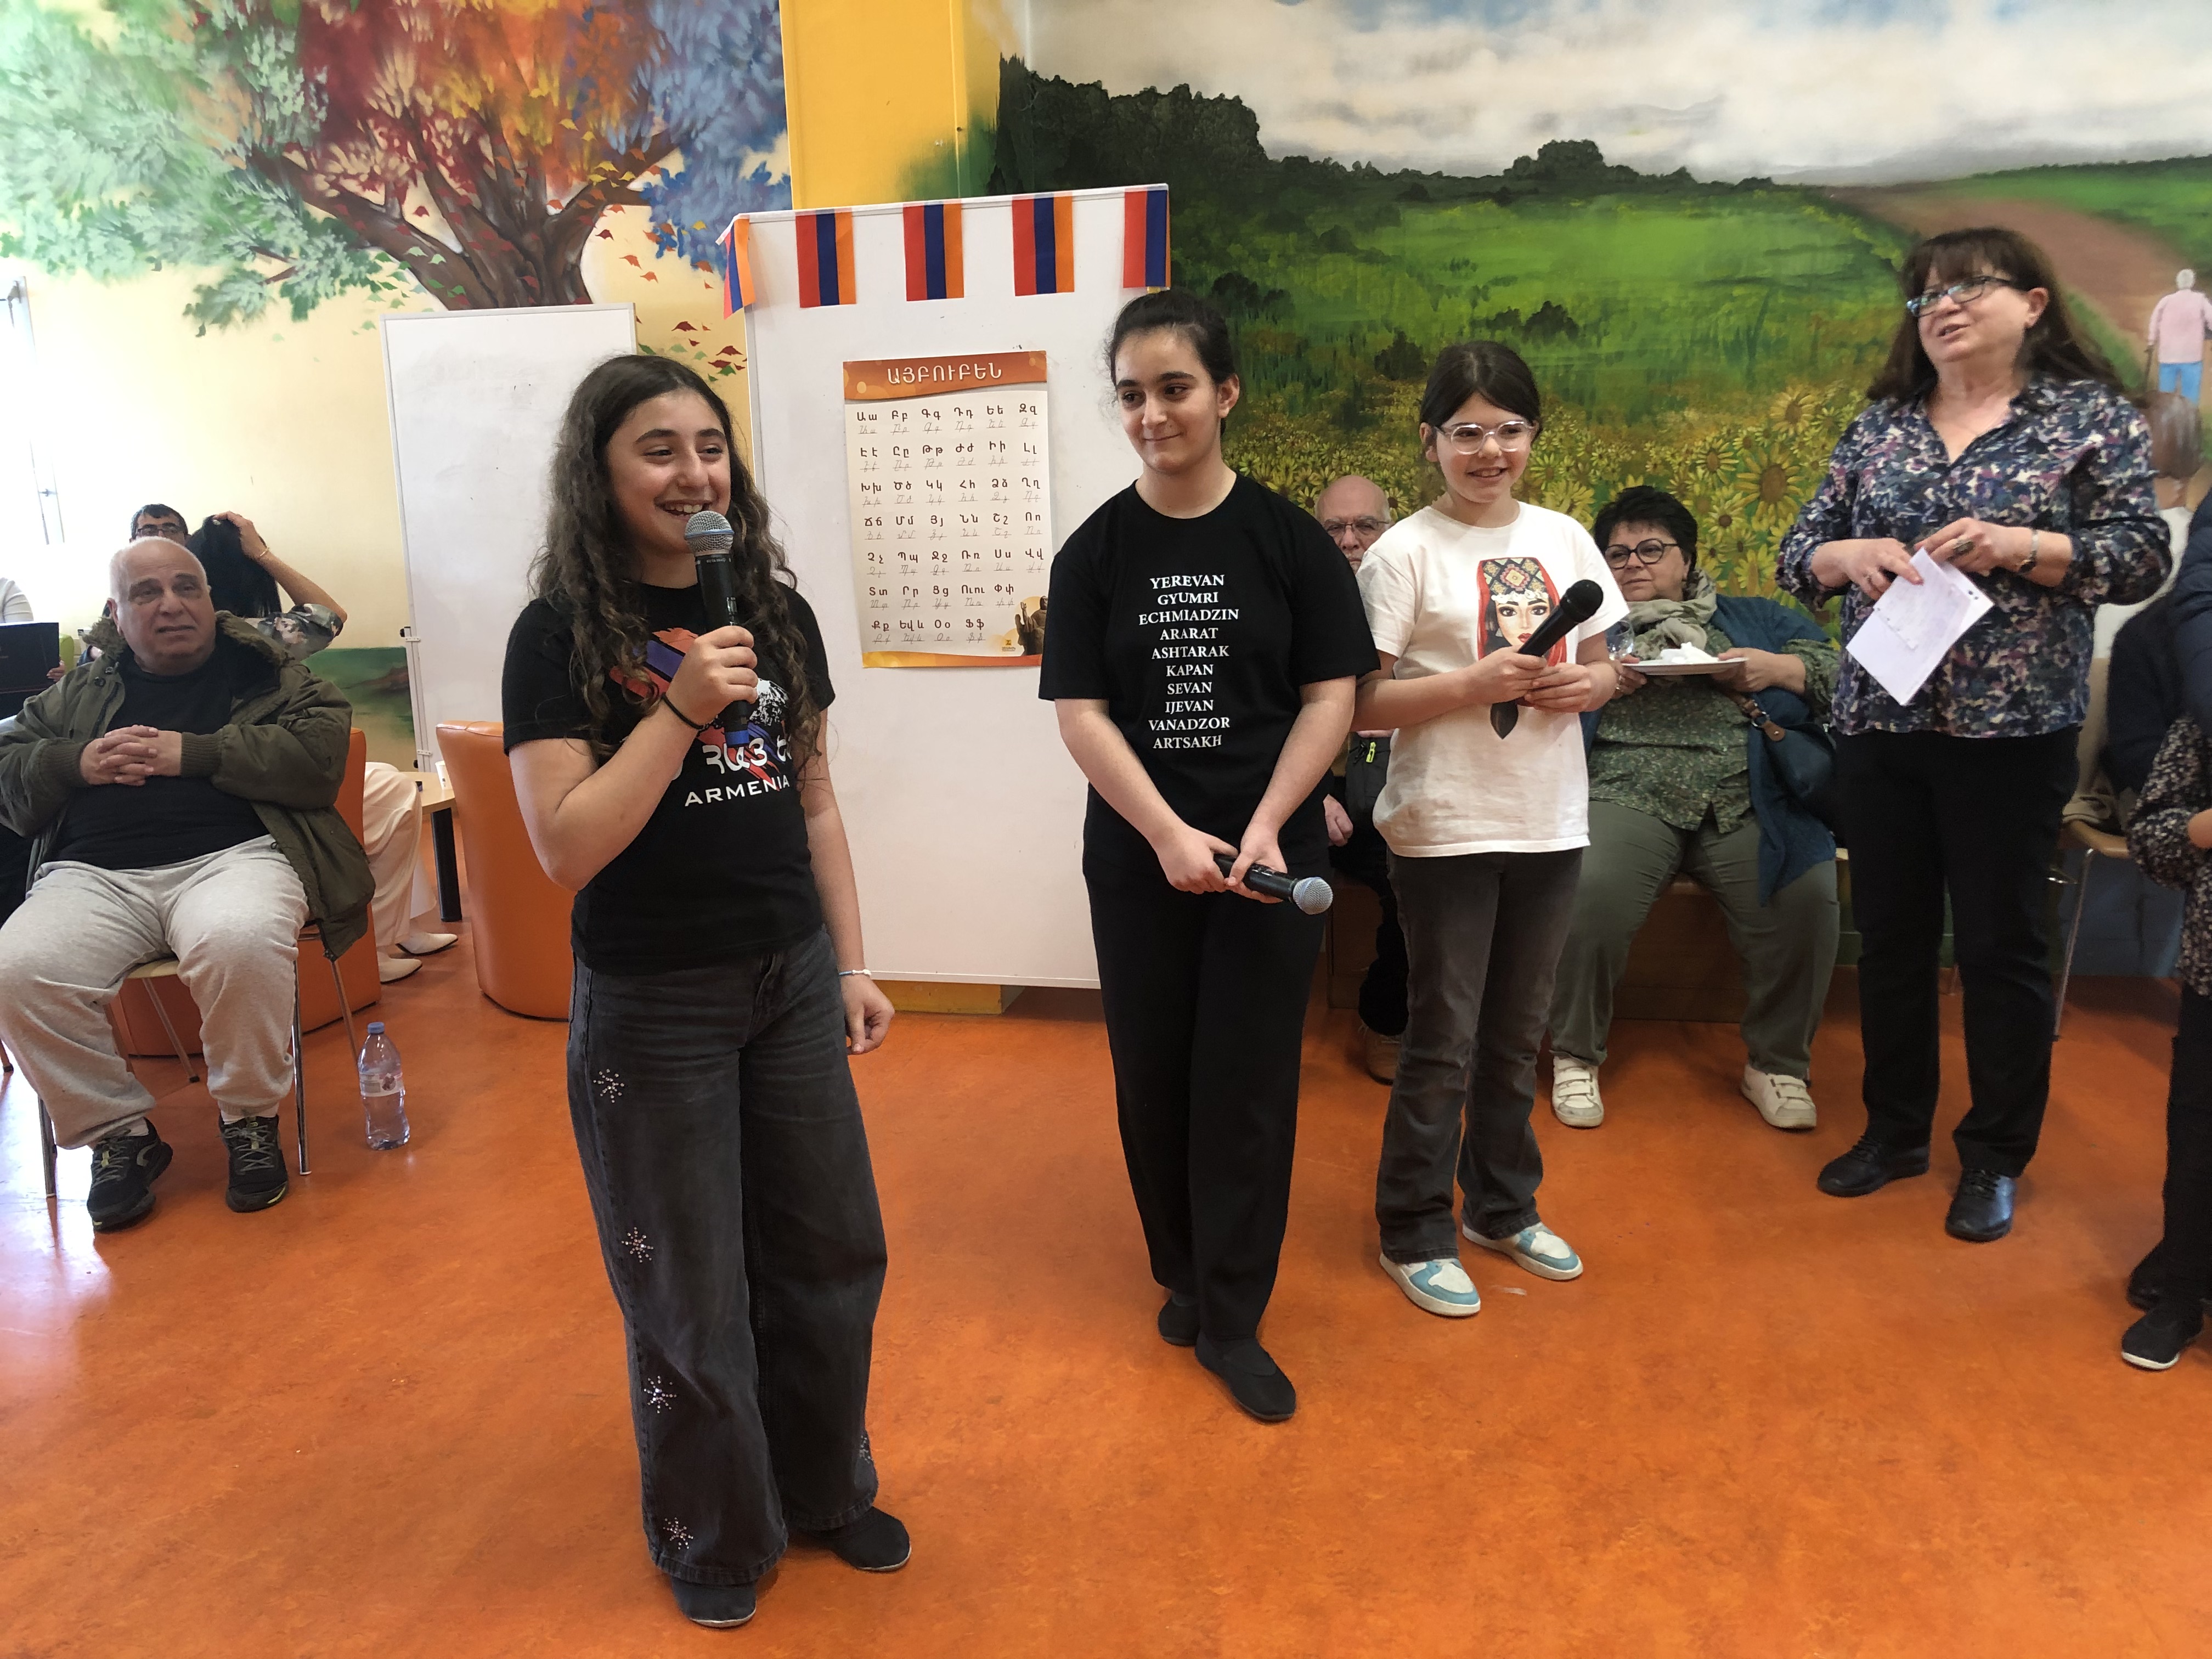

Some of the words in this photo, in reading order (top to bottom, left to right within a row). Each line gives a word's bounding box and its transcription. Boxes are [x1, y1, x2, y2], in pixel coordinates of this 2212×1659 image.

[888, 363, 1002, 385] ԱՅԲՈՒԲԵՆ
[1150, 574, 1224, 589] YEREVAN
[1158, 592, 1218, 605] GYUMRI
[1138, 609, 1239, 625] ECHMIADZIN
[1160, 628, 1218, 640] ARARAT
[1152, 646, 1229, 659] ASHTARAK
[1166, 664, 1214, 676] KAPAN
[1167, 682, 1212, 695] SEVAN
[1165, 700, 1214, 714] IJEVAN
[1148, 718, 1230, 731] VANADZOR
[1153, 735, 1222, 749] ARTSAKH
[685, 775, 790, 806] ARMENIA
